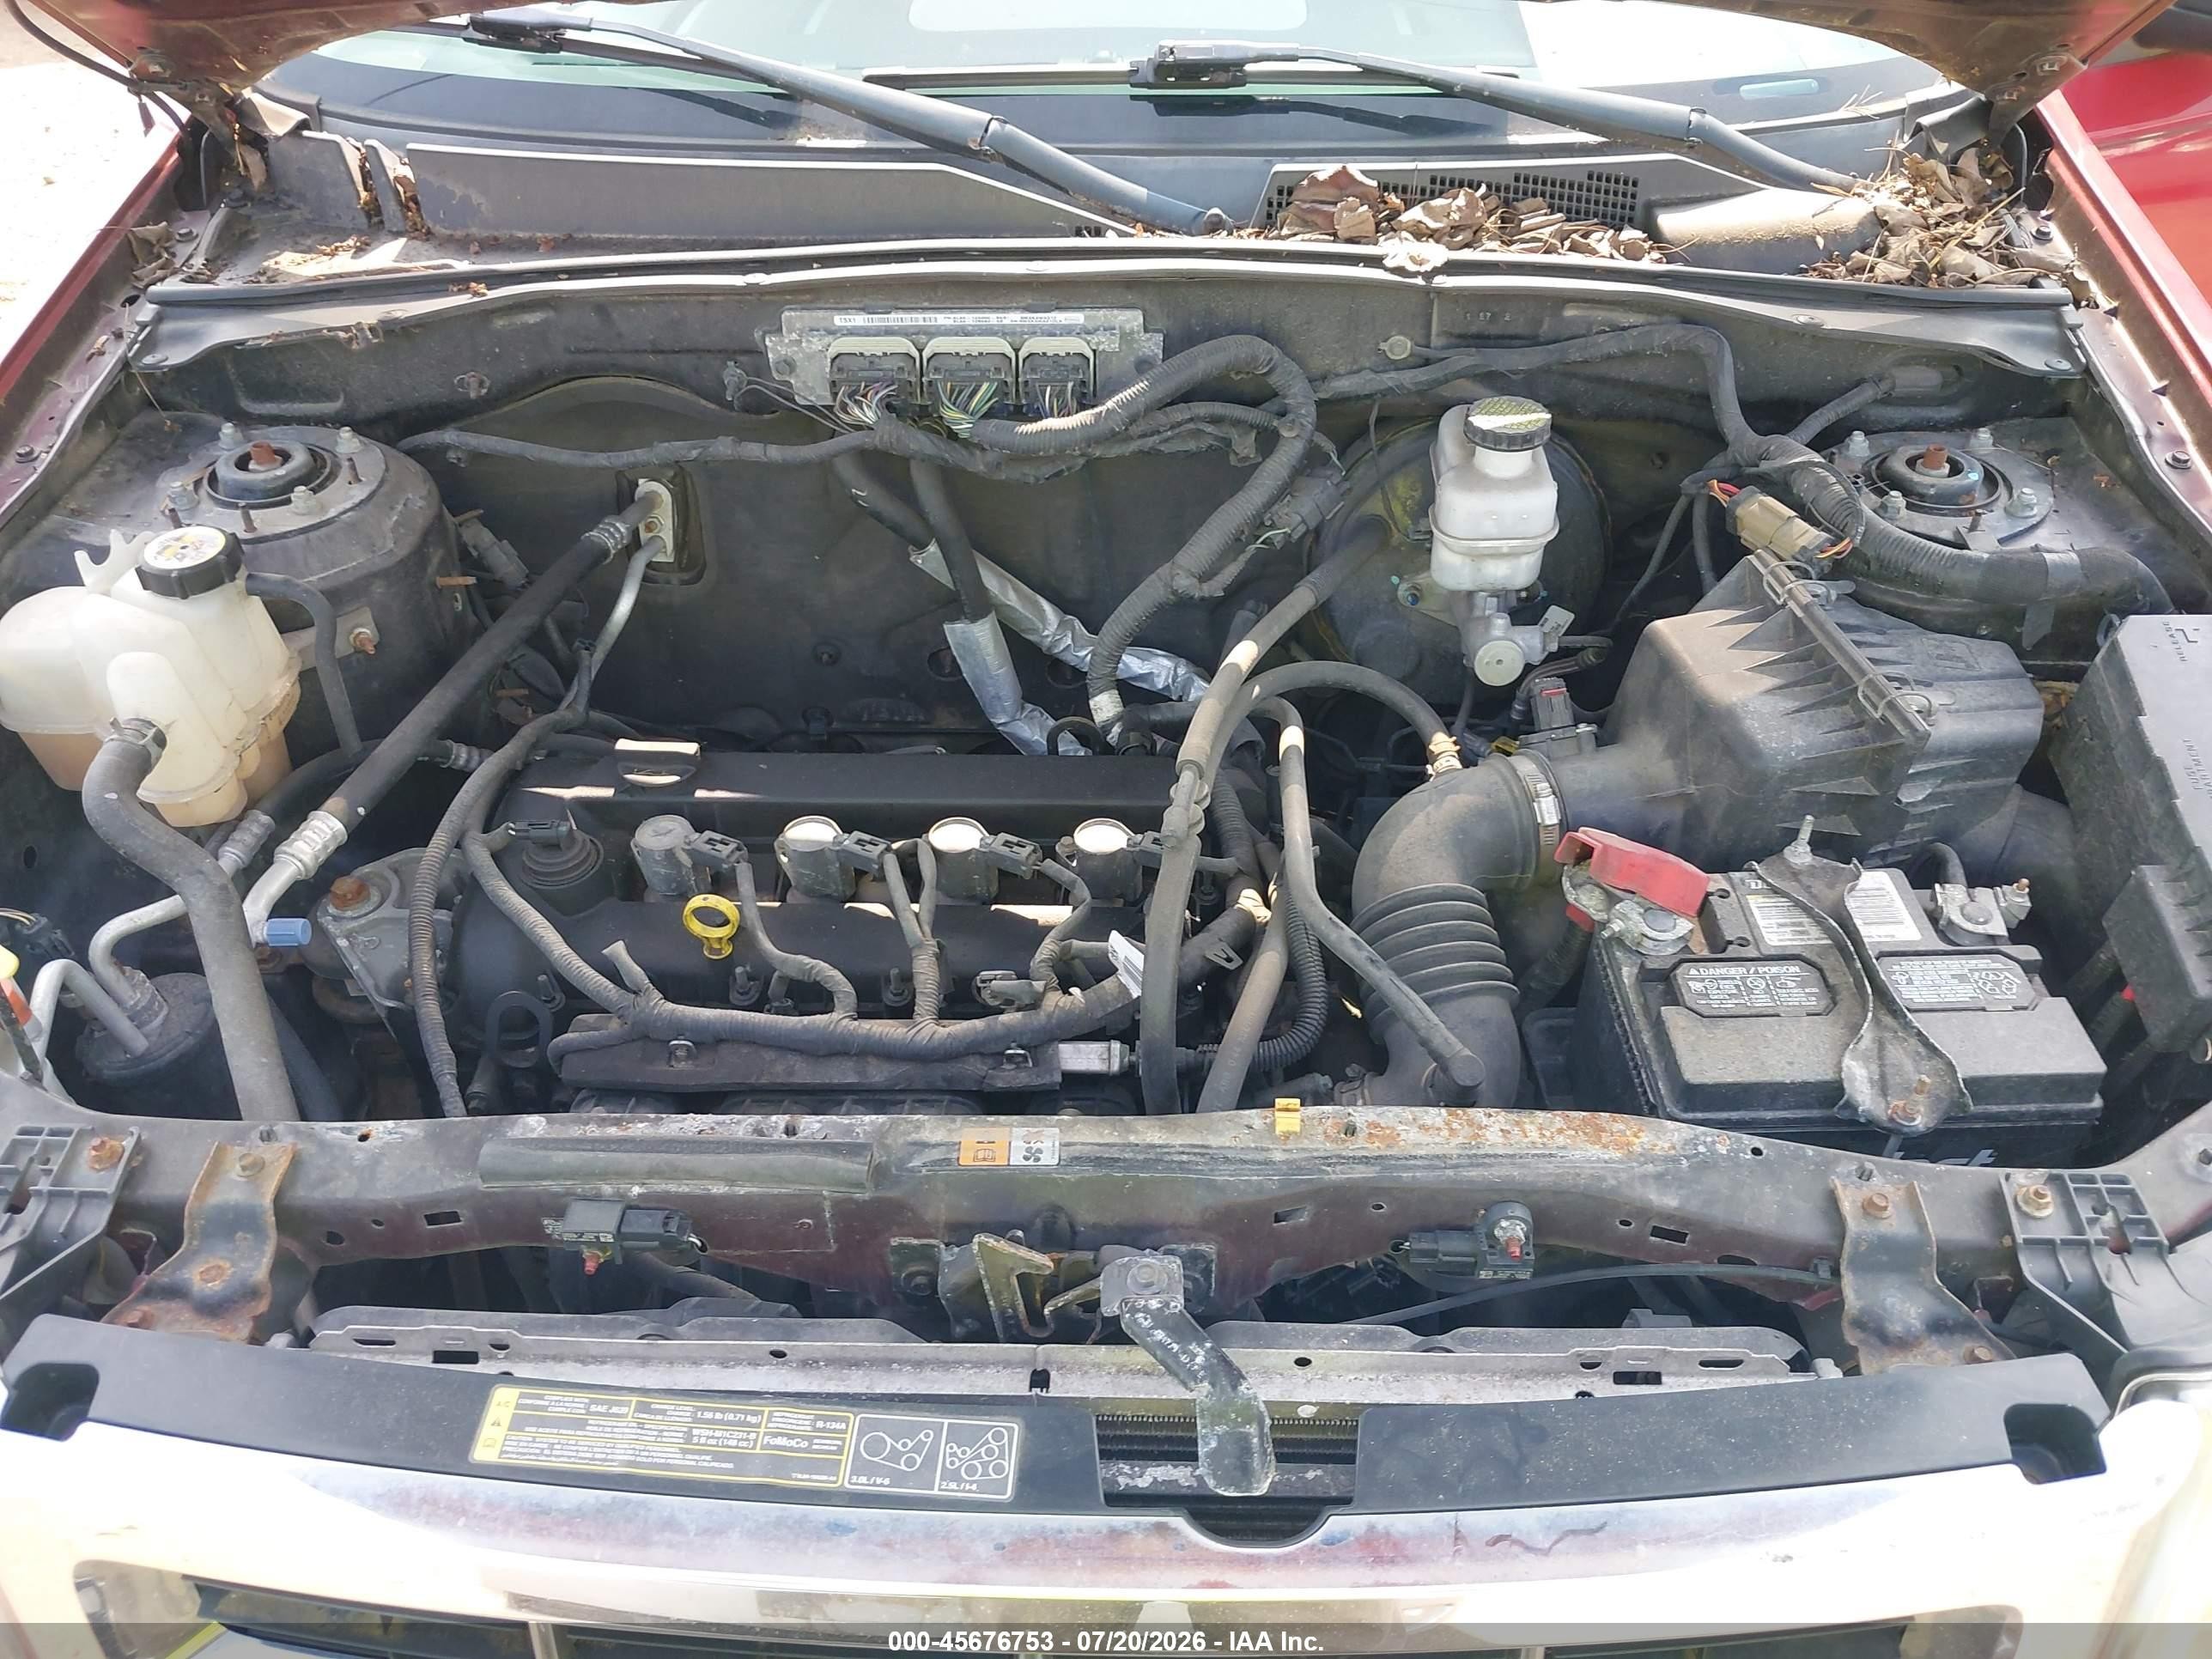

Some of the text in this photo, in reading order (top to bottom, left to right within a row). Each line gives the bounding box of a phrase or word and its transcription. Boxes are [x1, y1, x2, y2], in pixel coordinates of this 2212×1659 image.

[1698, 967, 1747, 975] DANGER
[1758, 965, 1801, 974] POISON
[589, 1404, 609, 1413] SAE
[816, 1419, 847, 1431] R-134A
[763, 1435, 809, 1449] FoMoCo
